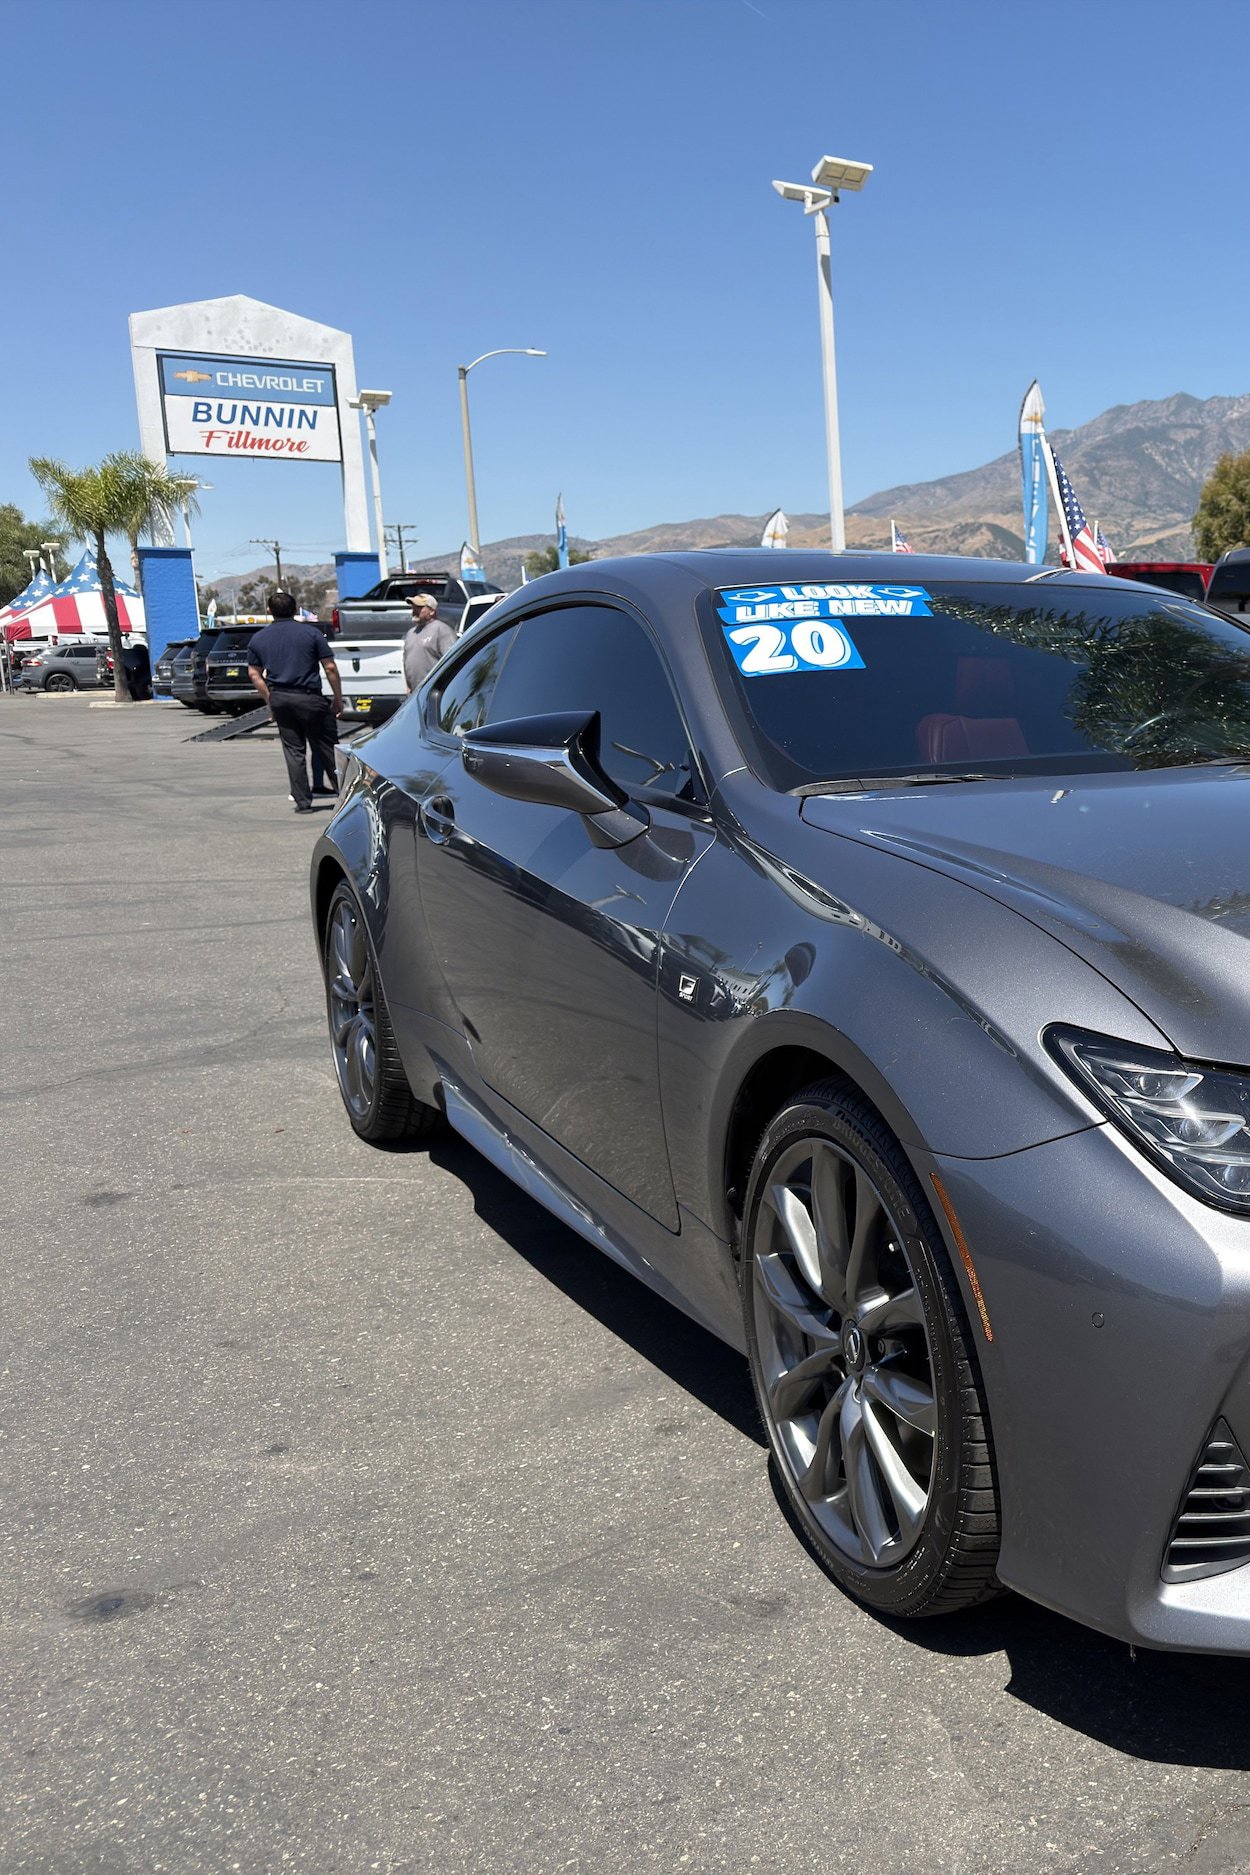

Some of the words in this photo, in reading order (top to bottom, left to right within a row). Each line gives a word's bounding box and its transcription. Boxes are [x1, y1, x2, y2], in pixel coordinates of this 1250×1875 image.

[216, 372, 324, 393] CHEVROLET
[192, 401, 318, 430] BUNNIN
[200, 429, 309, 453] Fillmore
[780, 585, 881, 600] LOOK
[735, 600, 820, 622] LIKE
[828, 599, 913, 616] NEW
[729, 620, 851, 674] 20
